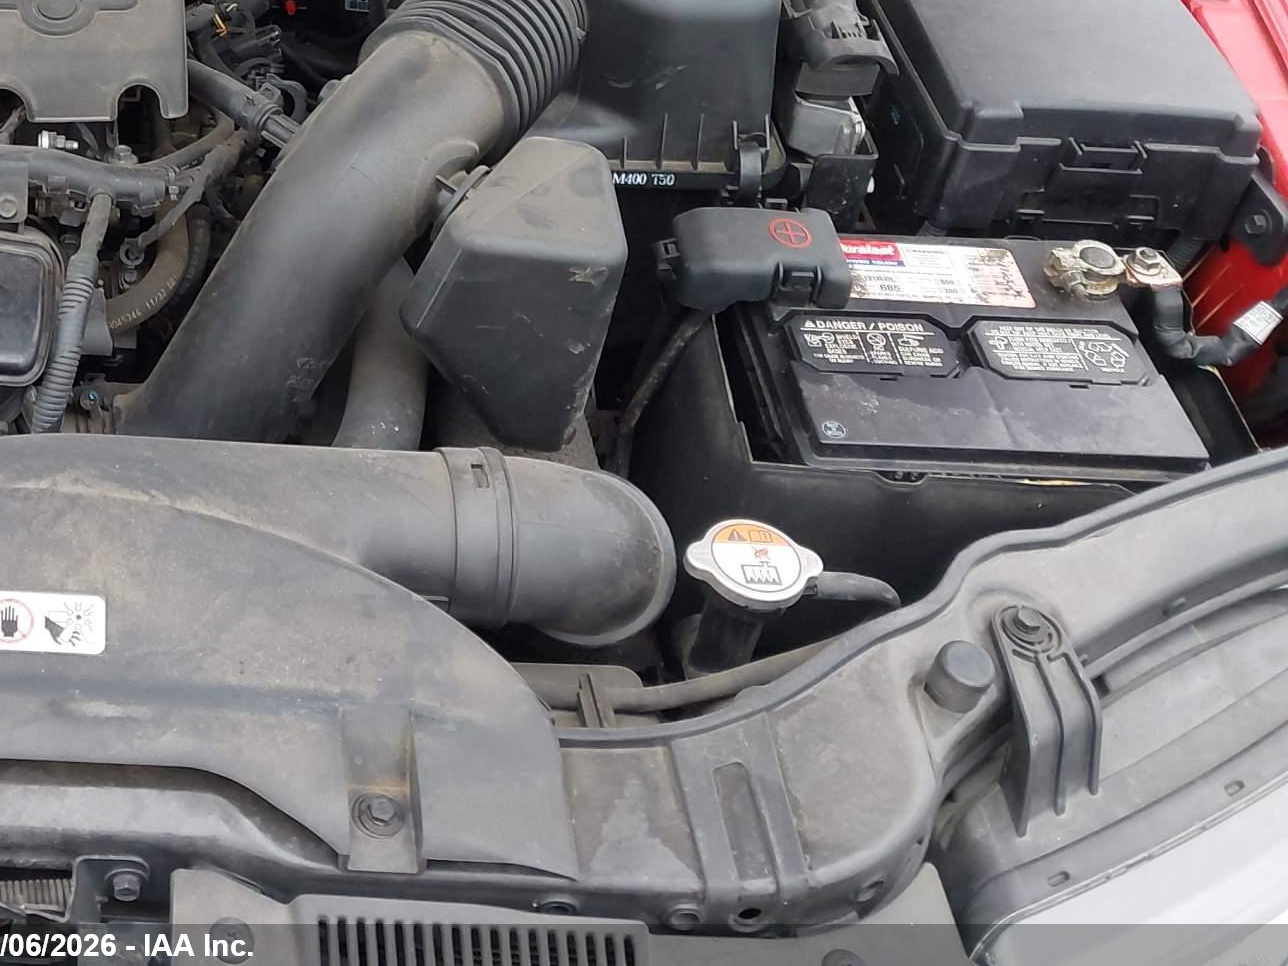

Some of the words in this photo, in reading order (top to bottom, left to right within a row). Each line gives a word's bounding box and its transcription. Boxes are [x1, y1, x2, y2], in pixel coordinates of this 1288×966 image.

[651, 173, 675, 186] T50
[840, 242, 896, 256] uralast
[816, 320, 866, 331] DANGER
[879, 322, 924, 333] POISON
